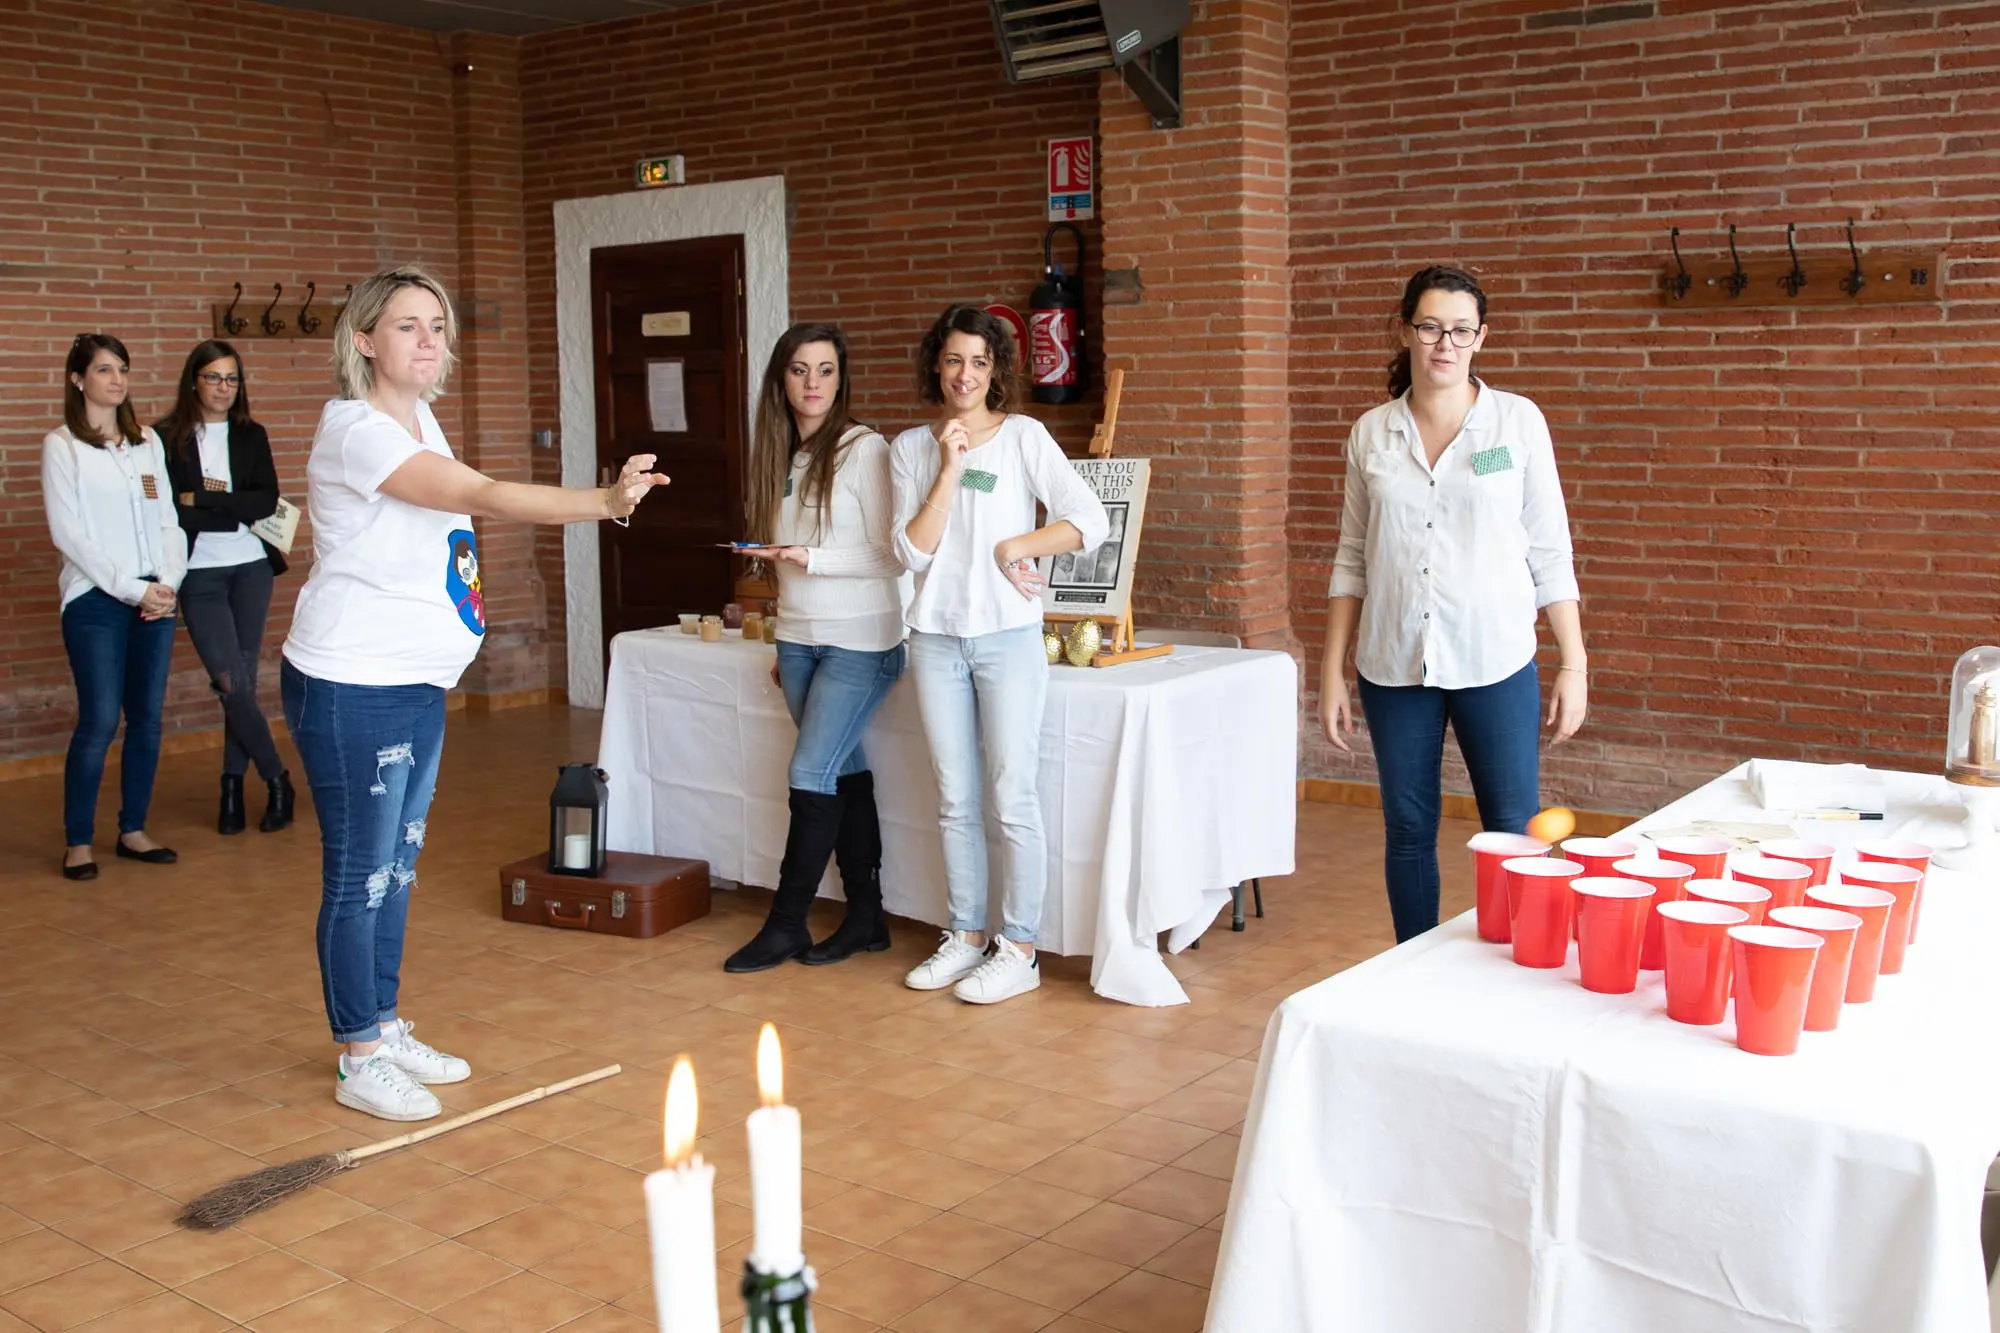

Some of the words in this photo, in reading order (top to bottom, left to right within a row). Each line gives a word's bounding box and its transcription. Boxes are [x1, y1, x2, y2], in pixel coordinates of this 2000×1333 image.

[1106, 461, 1136, 474] YOU
[1102, 475, 1134, 487] THIS
[1095, 487, 1127, 500] ARD?
